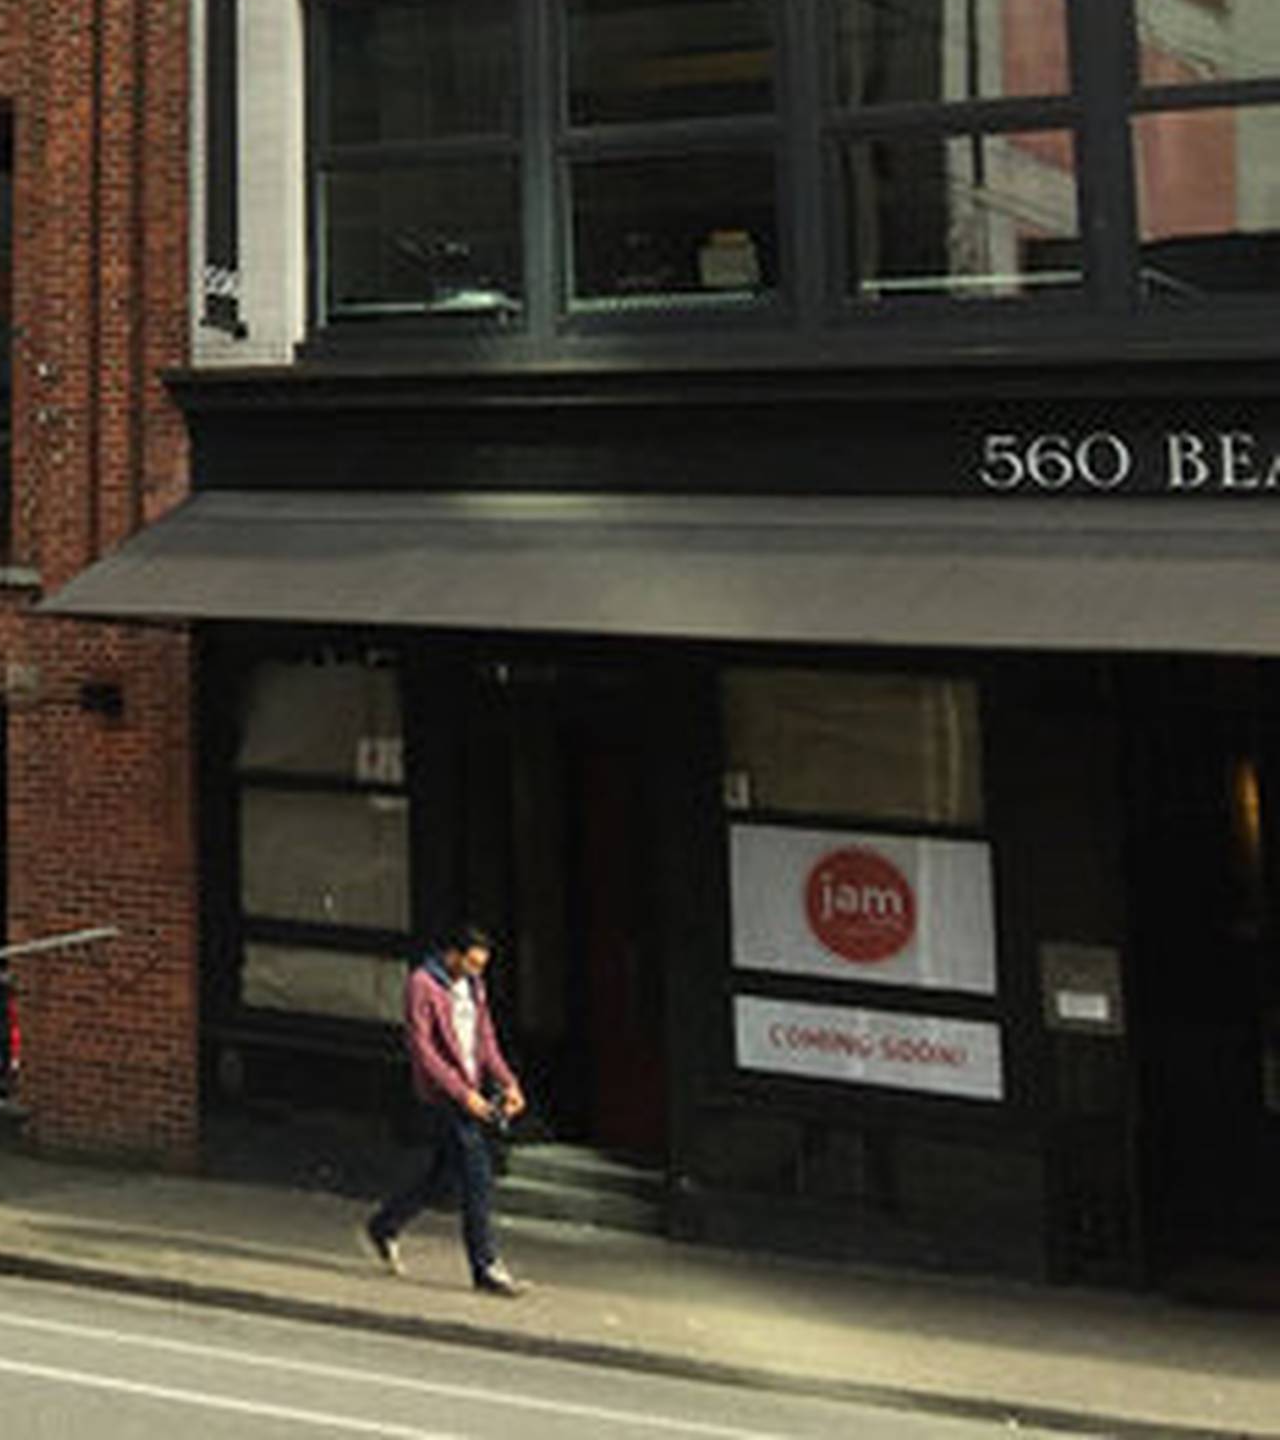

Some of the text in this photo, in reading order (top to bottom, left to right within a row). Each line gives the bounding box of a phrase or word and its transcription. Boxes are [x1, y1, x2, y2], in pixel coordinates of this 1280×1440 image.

[978, 432, 1131, 488] 560
[820, 871, 904, 921] jam
[767, 1021, 875, 1059] COMING
